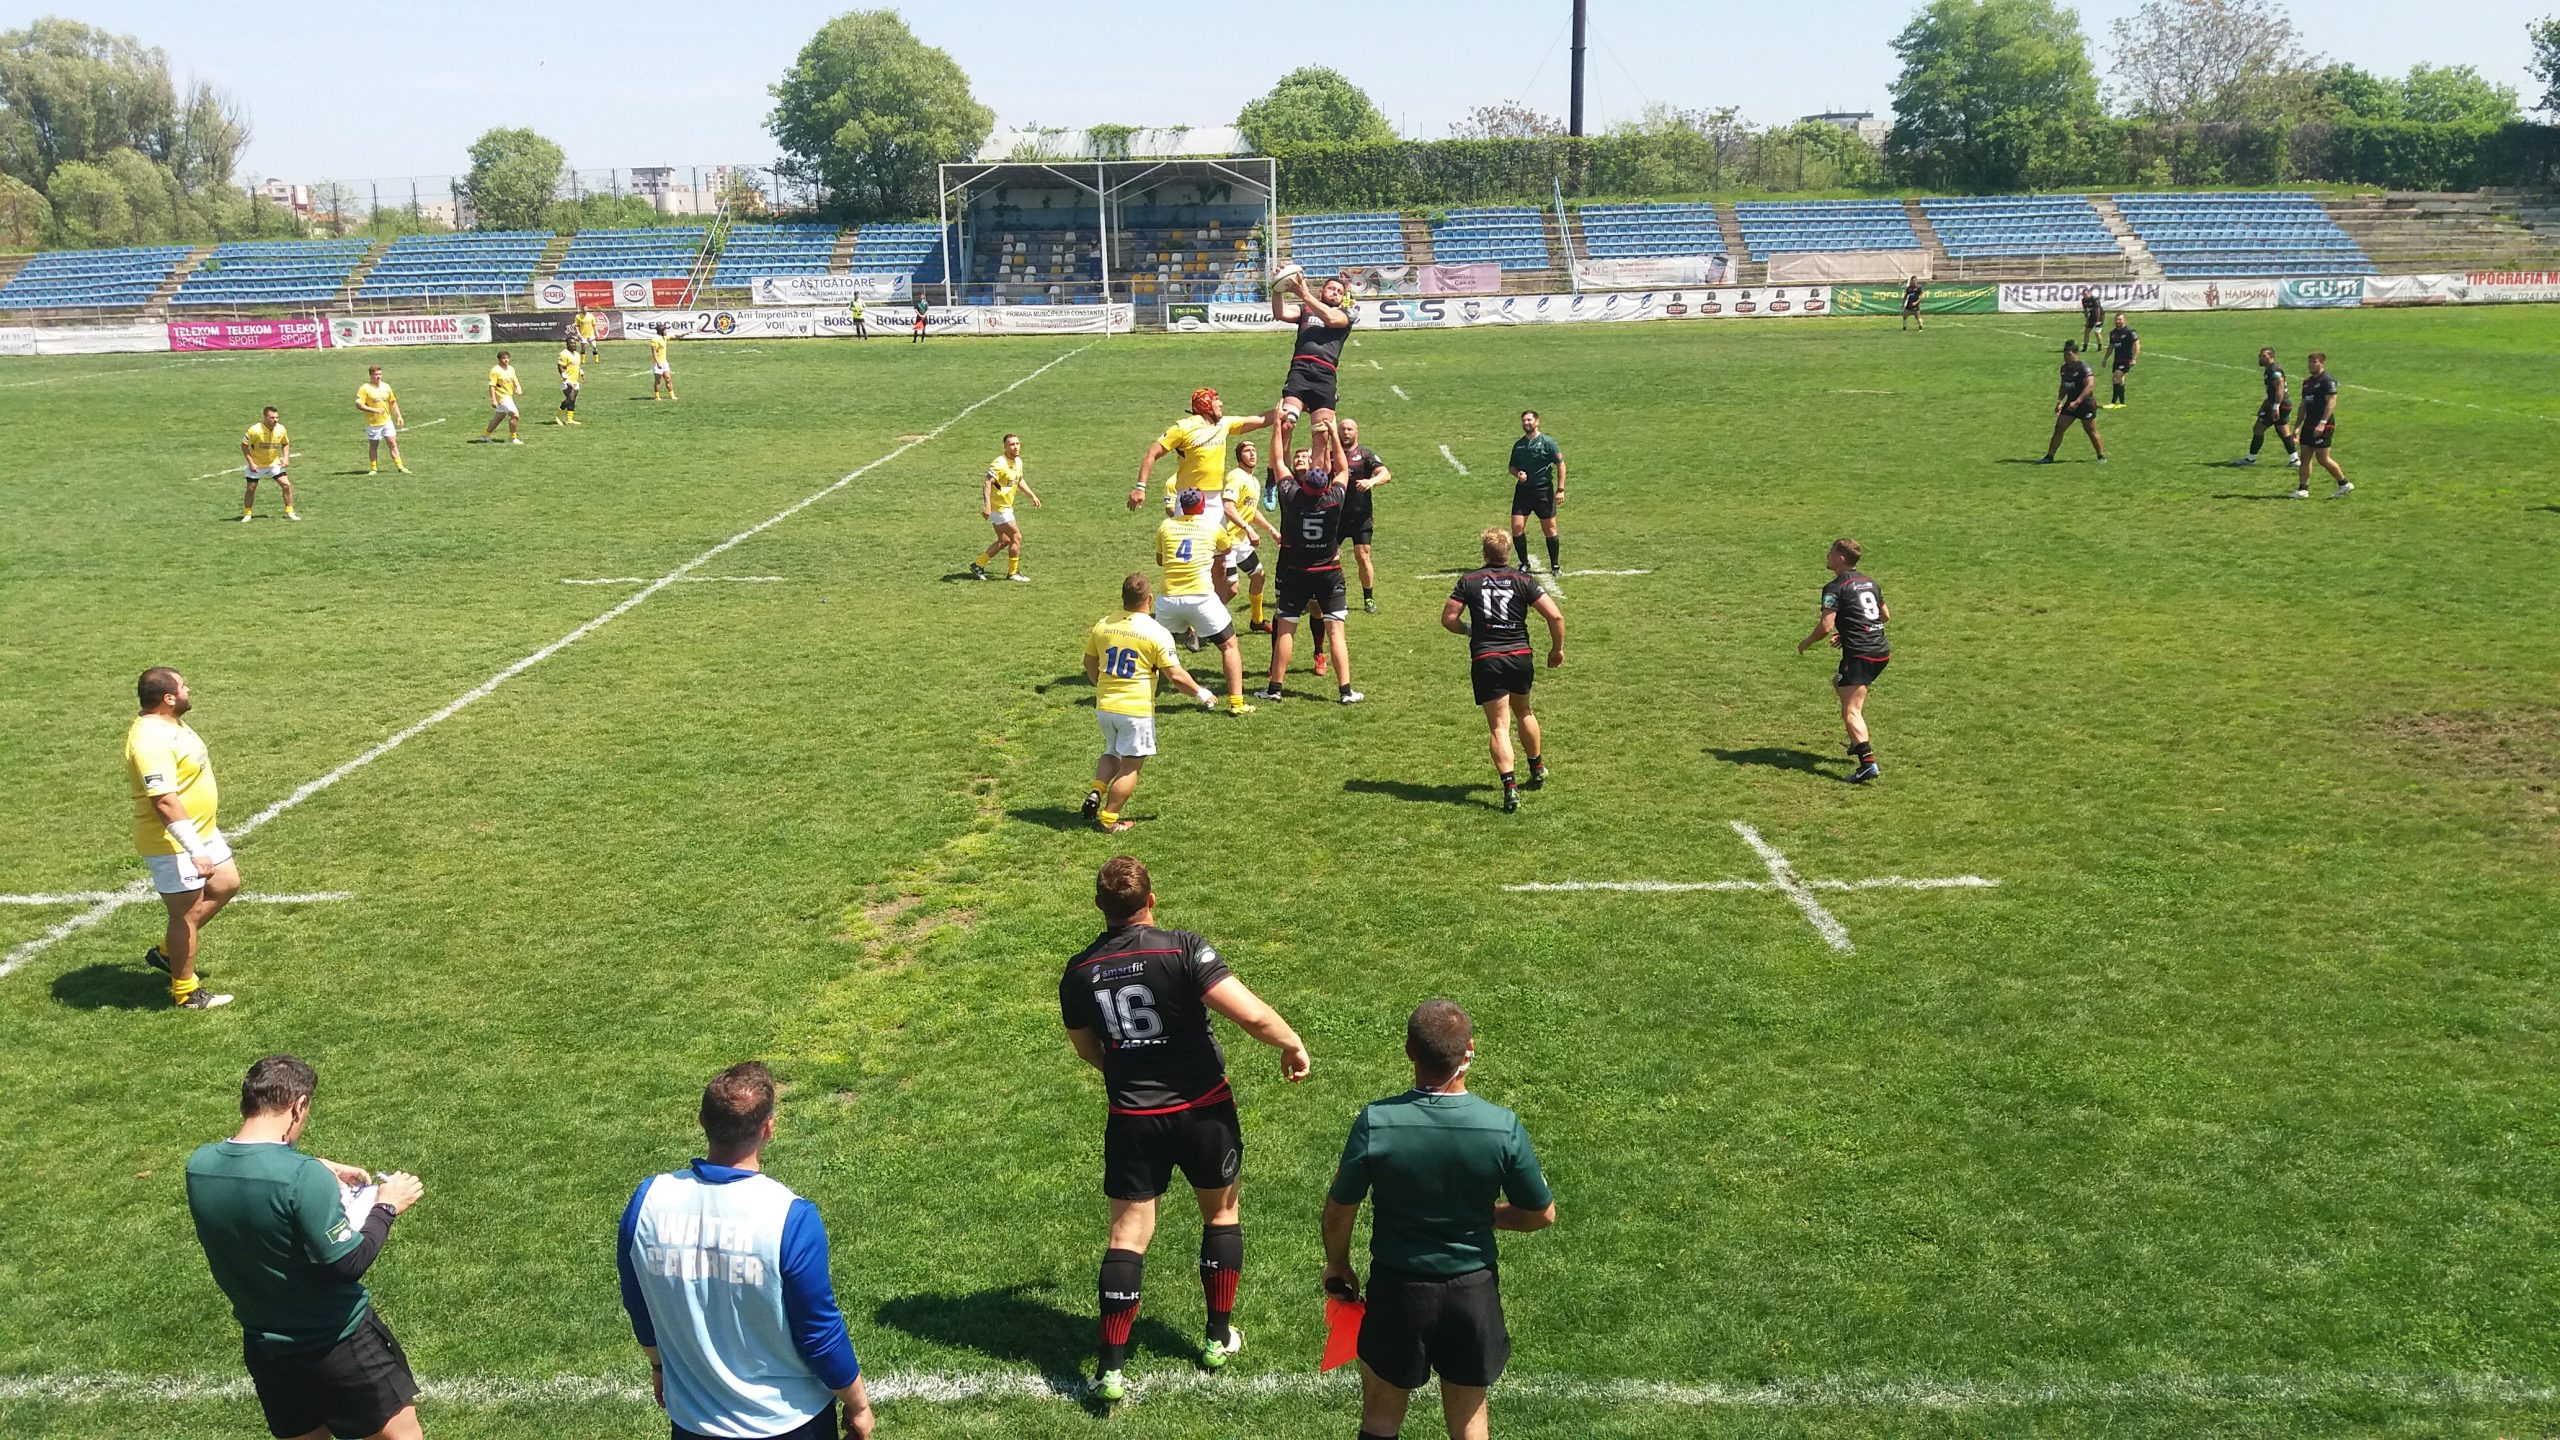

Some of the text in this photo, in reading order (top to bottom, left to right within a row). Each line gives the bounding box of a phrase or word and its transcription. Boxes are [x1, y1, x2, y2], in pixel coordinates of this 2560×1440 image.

[2466, 271, 2543, 286] TIPOGRAFIA
[544, 290, 564, 298] cora
[2004, 284, 2160, 301] METROPOLITAN
[363, 318, 458, 334] LVT ACTITRANS
[625, 321, 645, 330] ZIP
[876, 315, 917, 326] BORSEC
[927, 314, 969, 325] BORSEC
[173, 326, 219, 336] TELEKOM
[226, 325, 272, 335] TELEKOM
[176, 337, 207, 347] SPORT
[228, 335, 260, 345] SPORT
[281, 333, 312, 344] SPORT
[1302, 518, 1324, 540] 5
[1175, 538, 1193, 563] 4
[1481, 588, 1514, 620] 17
[1103, 626, 1148, 641] metropolitan
[1105, 646, 1139, 679] 16
[1102, 962, 1144, 977] smartfit
[1094, 984, 1164, 1040] 16
[657, 1212, 754, 1252] WATER
[647, 1247, 764, 1286] CARRIER
